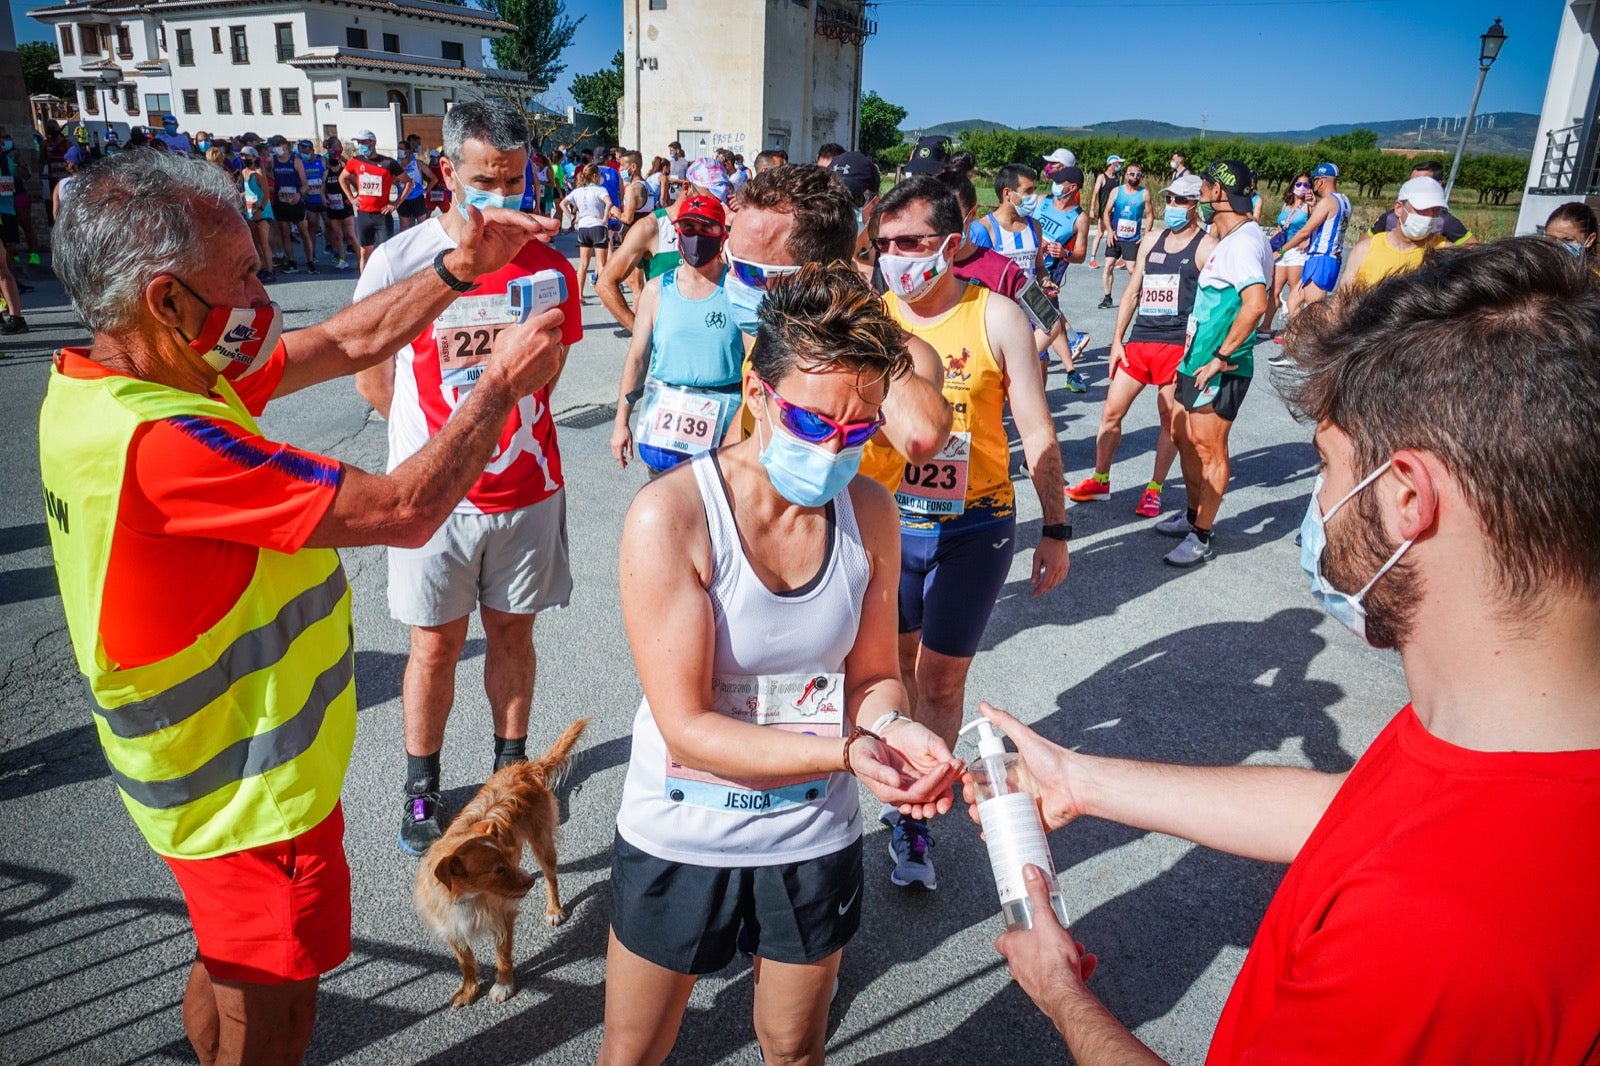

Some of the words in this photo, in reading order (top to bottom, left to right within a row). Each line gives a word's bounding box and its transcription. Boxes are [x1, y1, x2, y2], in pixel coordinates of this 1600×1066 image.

[362, 182, 379, 190] 2077
[1146, 290, 1174, 302] 2058
[232, 324, 256, 338] NIKE
[213, 345, 254, 364] Plus500
[661, 412, 708, 437] 2139
[901, 463, 957, 490] 023
[917, 498, 953, 512] ALFONSO
[724, 792, 771, 810] JESICA
